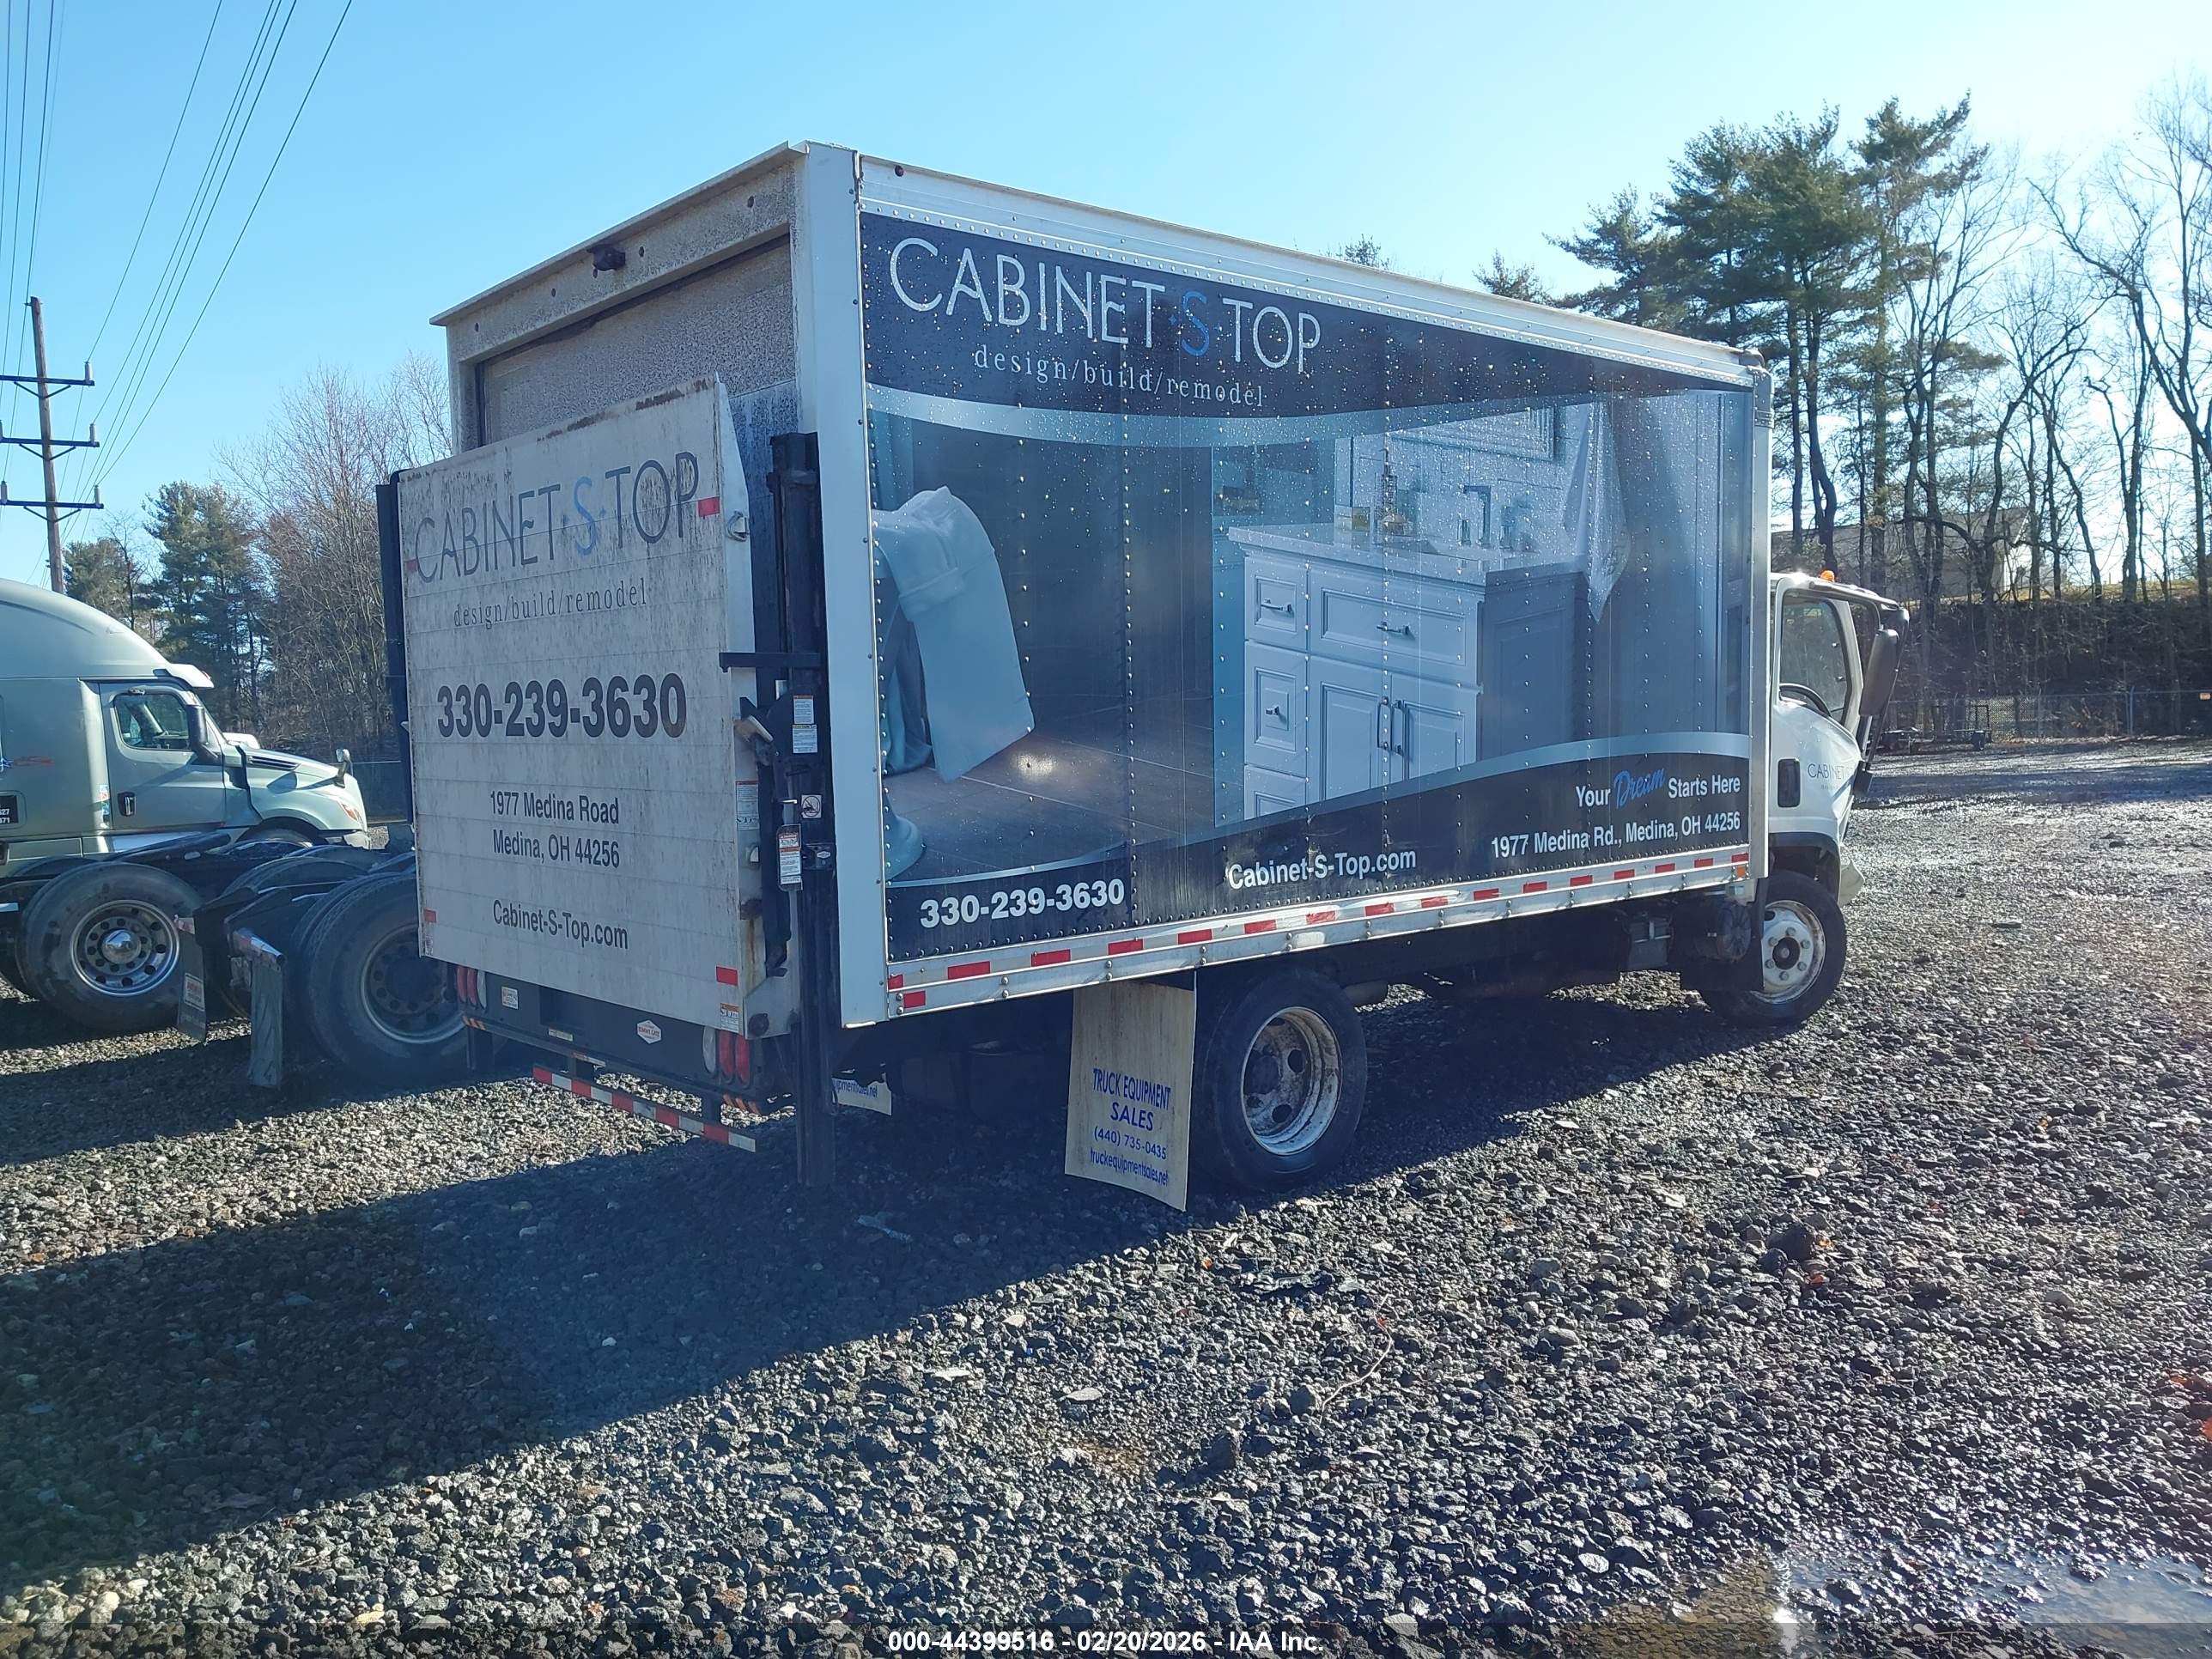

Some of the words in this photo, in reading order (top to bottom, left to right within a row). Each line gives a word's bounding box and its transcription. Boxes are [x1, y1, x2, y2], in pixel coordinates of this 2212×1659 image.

[890, 237, 1166, 349] CABINET
[1222, 297, 1322, 373] TOP
[975, 343, 1264, 407] design/build/remodel
[415, 483, 561, 583] CABINET
[605, 452, 699, 549] TOP
[453, 577, 647, 629] design/build/remodel
[437, 672, 687, 738] 330-239-3630
[490, 790, 520, 816] 1977
[523, 792, 574, 821] Medina
[579, 794, 619, 824] Road
[1576, 784, 1611, 807] Your
[1613, 768, 1665, 810] Dream
[1668, 775, 1708, 799] Starts
[1711, 775, 1741, 794] Here
[493, 829, 544, 864] Medina,
[548, 834, 570, 862] OH
[574, 837, 620, 869] 44256
[1491, 833, 1529, 859] 1977
[1534, 830, 1589, 854] Medina
[1594, 826, 1622, 848] Rd.,
[1626, 819, 1678, 842] Medina,
[1681, 815, 1701, 836] OH
[1705, 811, 1741, 832] 44256
[1228, 850, 1416, 890] Cabinet-S-Top.com
[493, 899, 629, 950] Cabinet-S-Top.com
[920, 878, 1125, 928] 330-239-3630
[1093, 1068, 1121, 1097] TRUCK
[1123, 1074, 1171, 1111] EQUIPMENT
[1110, 1102, 1154, 1132] SALES
[1094, 1126, 1121, 1146] (440)
[1124, 1134, 1167, 1160] 735-0435
[1091, 1146, 1169, 1187] truckequipmentsales.net
